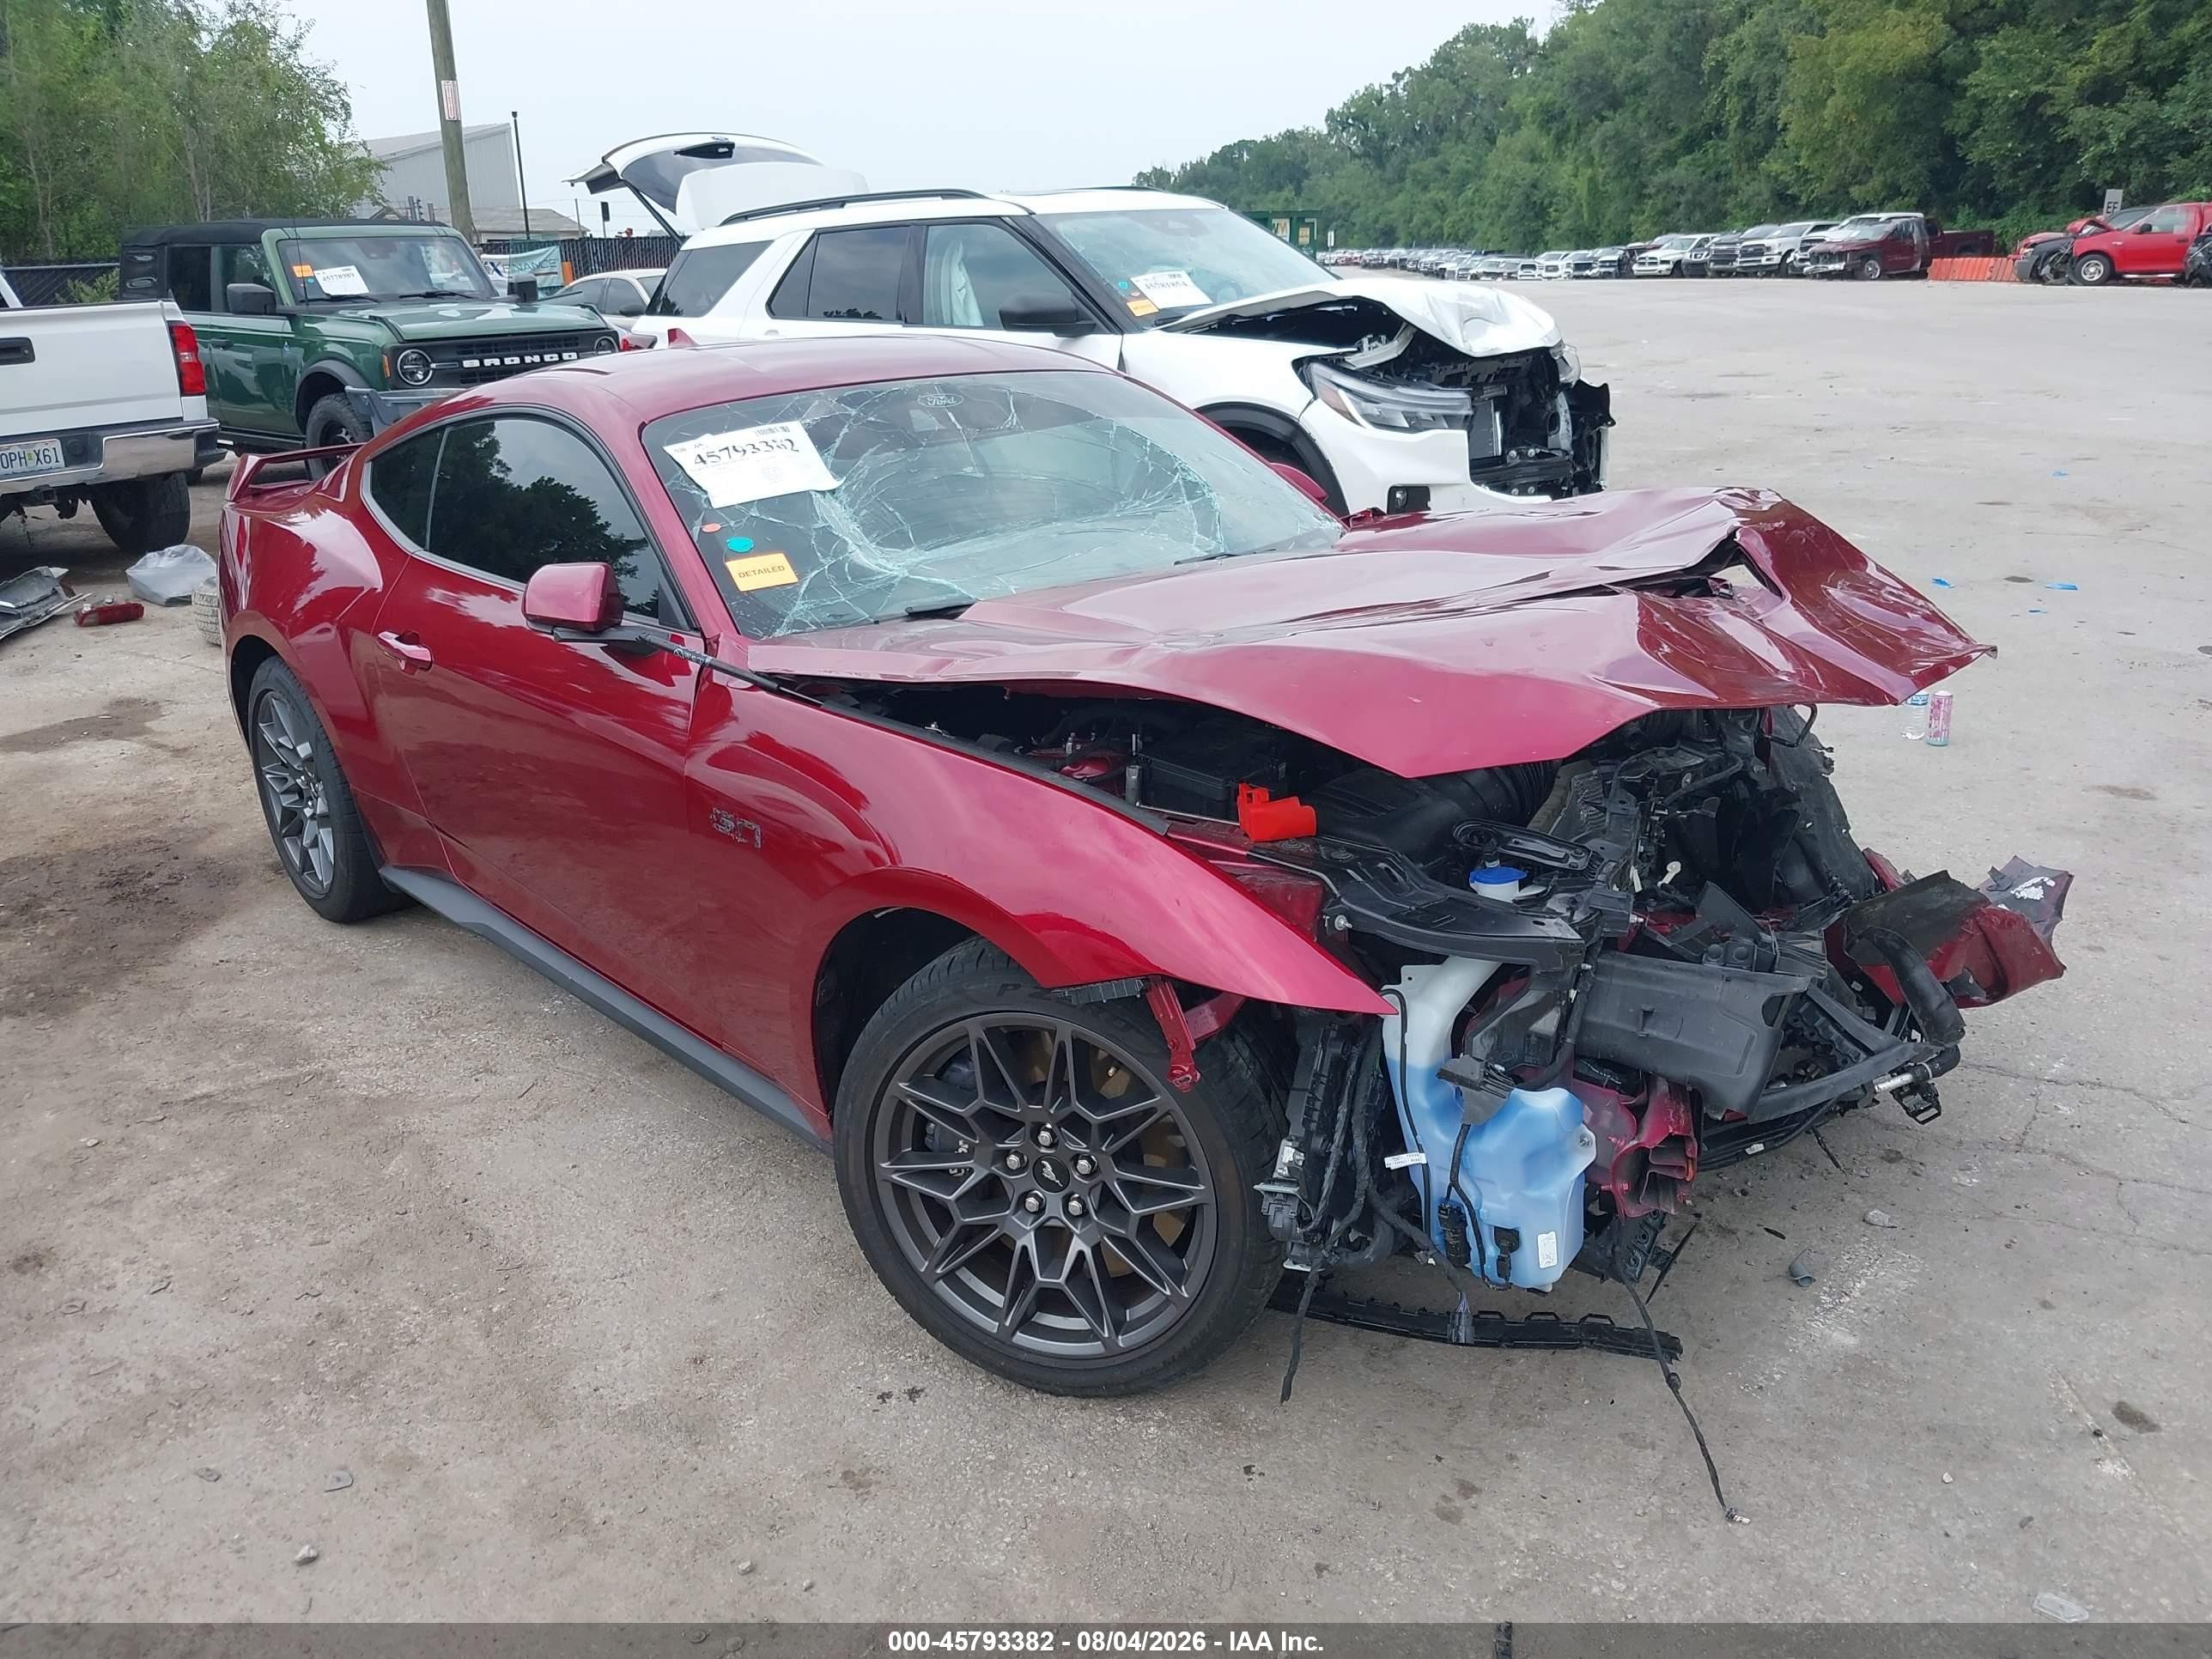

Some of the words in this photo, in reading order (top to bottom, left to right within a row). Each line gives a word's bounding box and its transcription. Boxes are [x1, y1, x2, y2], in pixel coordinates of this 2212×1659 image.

[462, 352, 578, 368] BRONCO
[33, 447, 60, 466] X61
[738, 565, 786, 579] DETAILED
